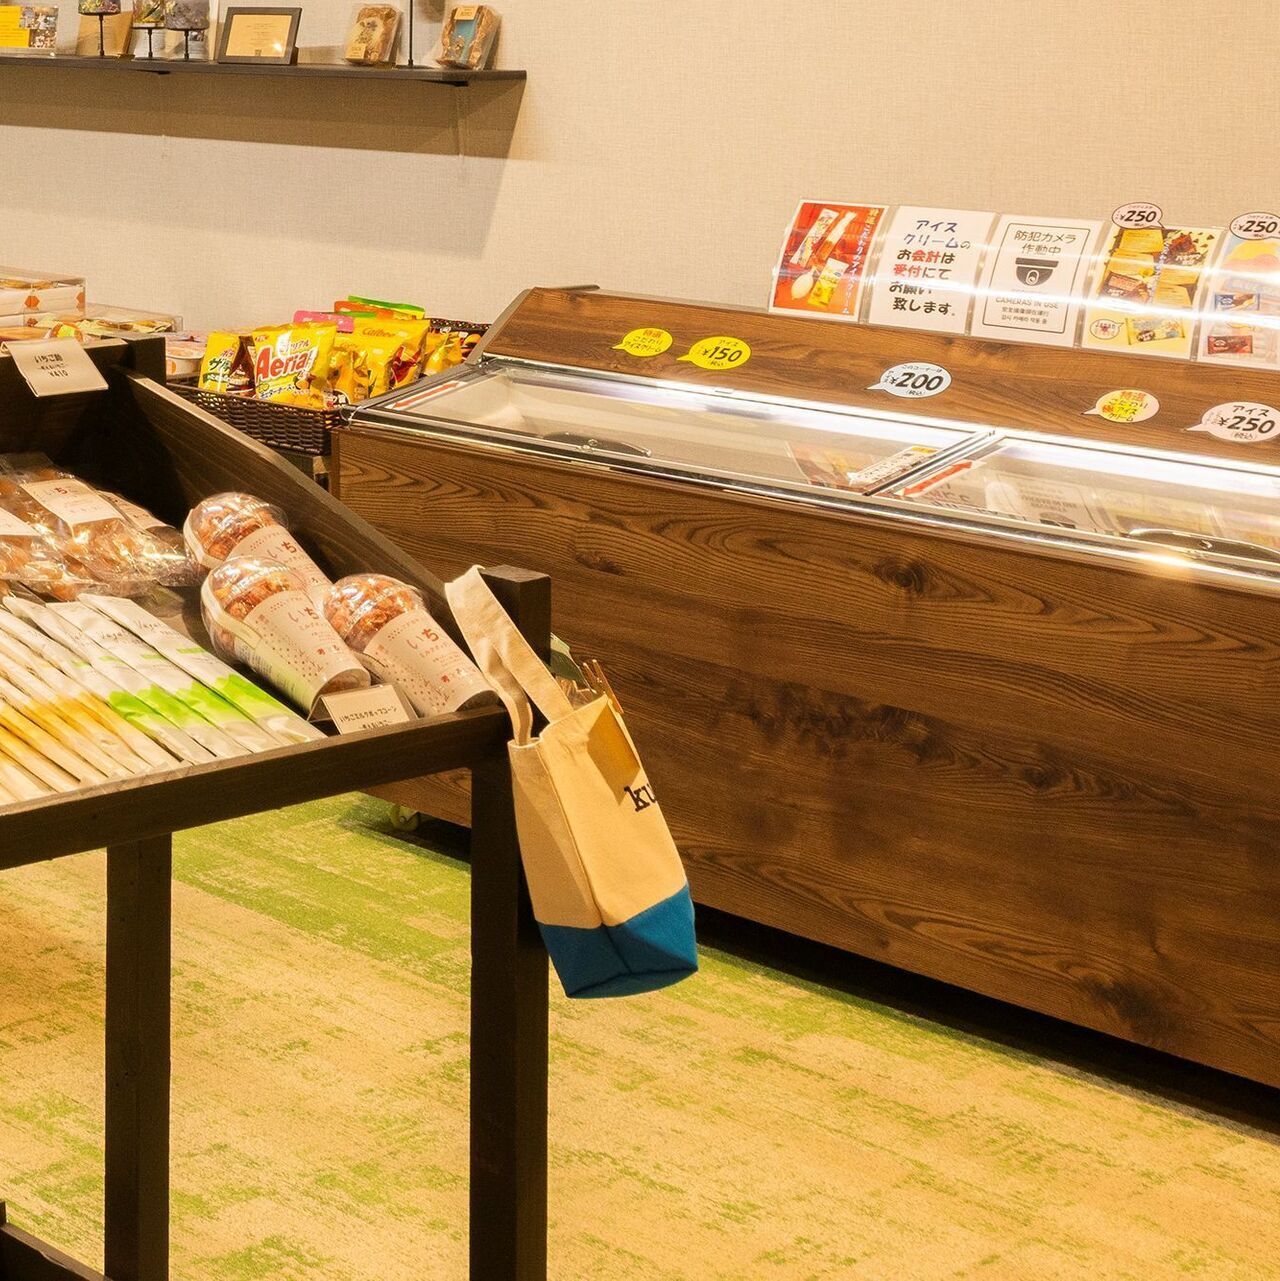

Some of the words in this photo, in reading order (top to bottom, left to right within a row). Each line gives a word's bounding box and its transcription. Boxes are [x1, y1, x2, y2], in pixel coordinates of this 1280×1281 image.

[915, 219, 958, 234] アイス
[903, 233, 971, 250] クリームの
[1013, 229, 1077, 245] 防犯カメラ
[896, 248, 956, 265] お会計は
[1021, 243, 1062, 257] 作動中
[893, 263, 952, 281] 受付にて
[892, 296, 956, 317] 致します。
[701, 345, 744, 363] ¥150
[889, 371, 945, 391] ¥200
[1232, 404, 1270, 418] アイス
[1218, 415, 1276, 434] ¥250
